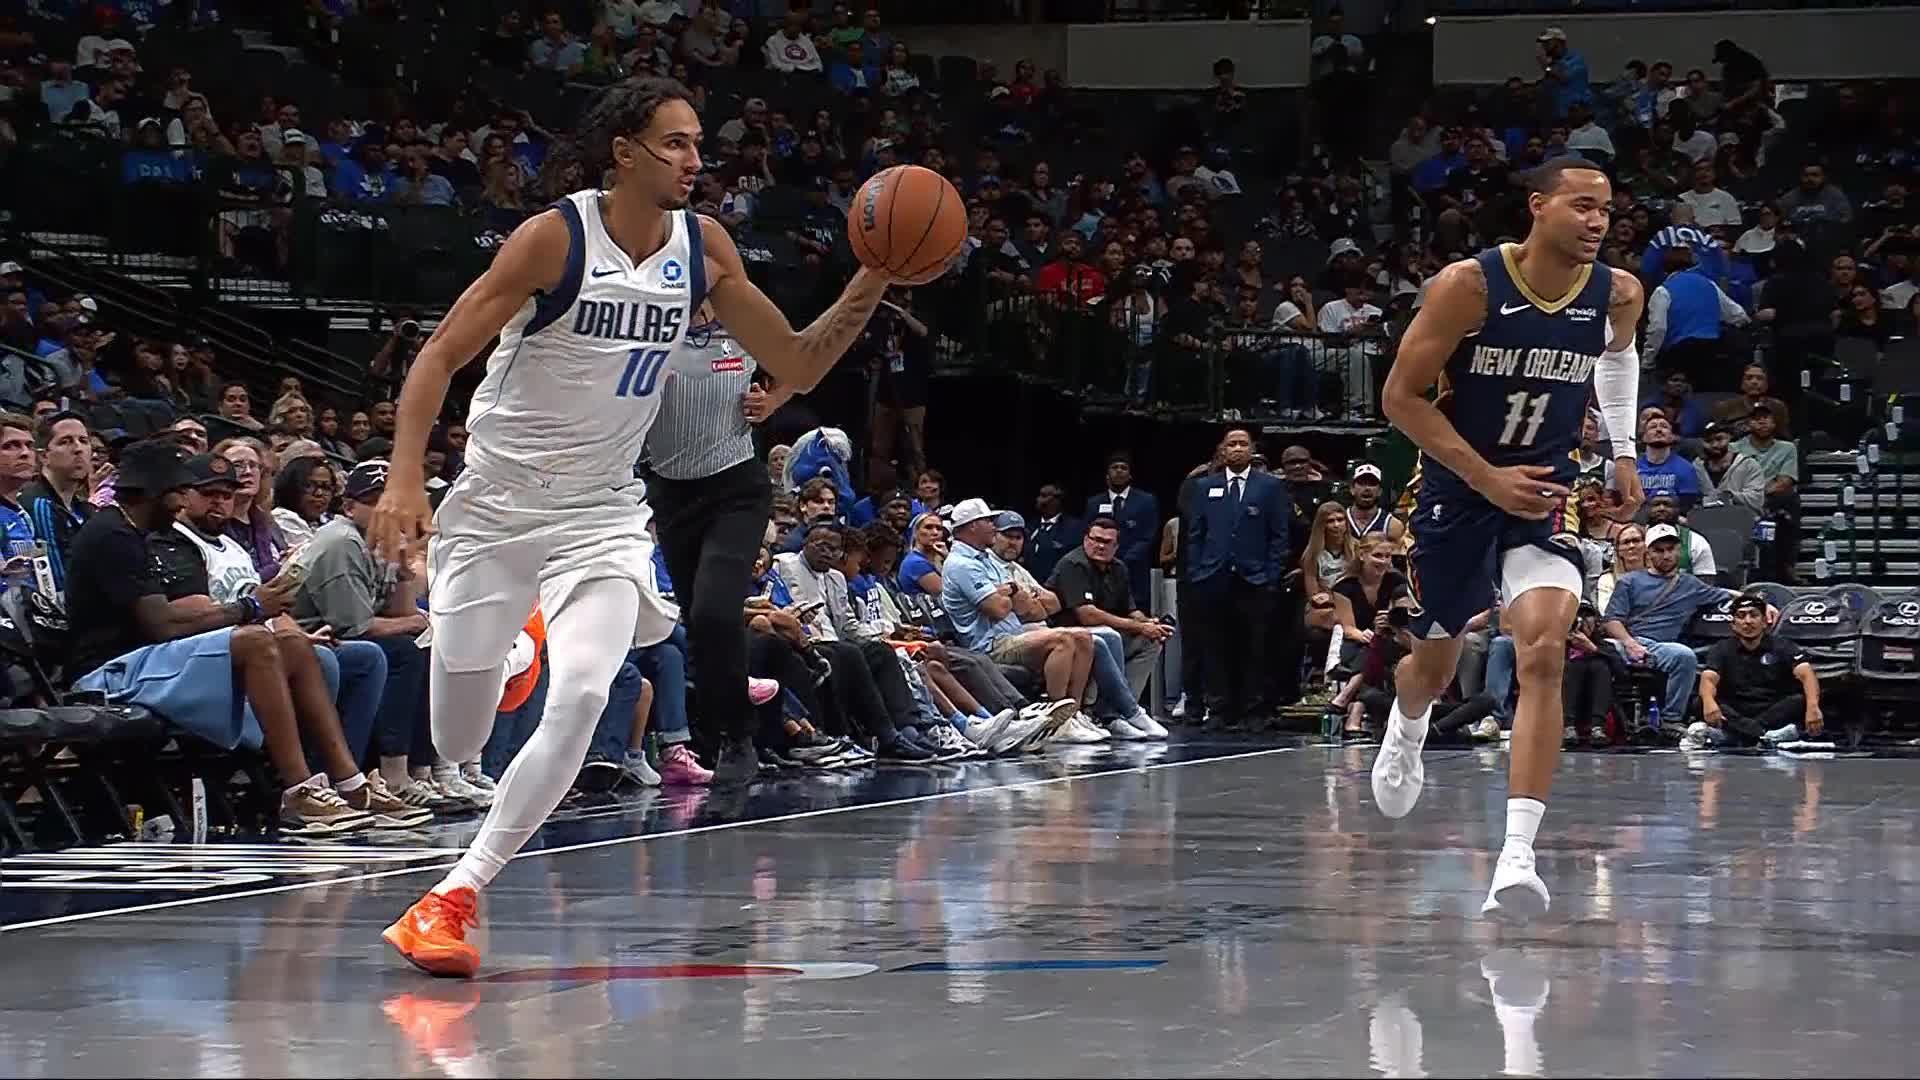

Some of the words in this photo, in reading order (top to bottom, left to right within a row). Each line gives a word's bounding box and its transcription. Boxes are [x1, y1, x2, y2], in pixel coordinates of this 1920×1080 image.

[573, 300, 684, 343] DALLAS
[616, 348, 671, 397] 10
[1469, 344, 1522, 376] NEW
[1498, 390, 1552, 446] 11
[1702, 613, 1734, 621] LEX
[1789, 615, 1840, 624] LEXUS
[1882, 616, 1920, 625] LEXU
